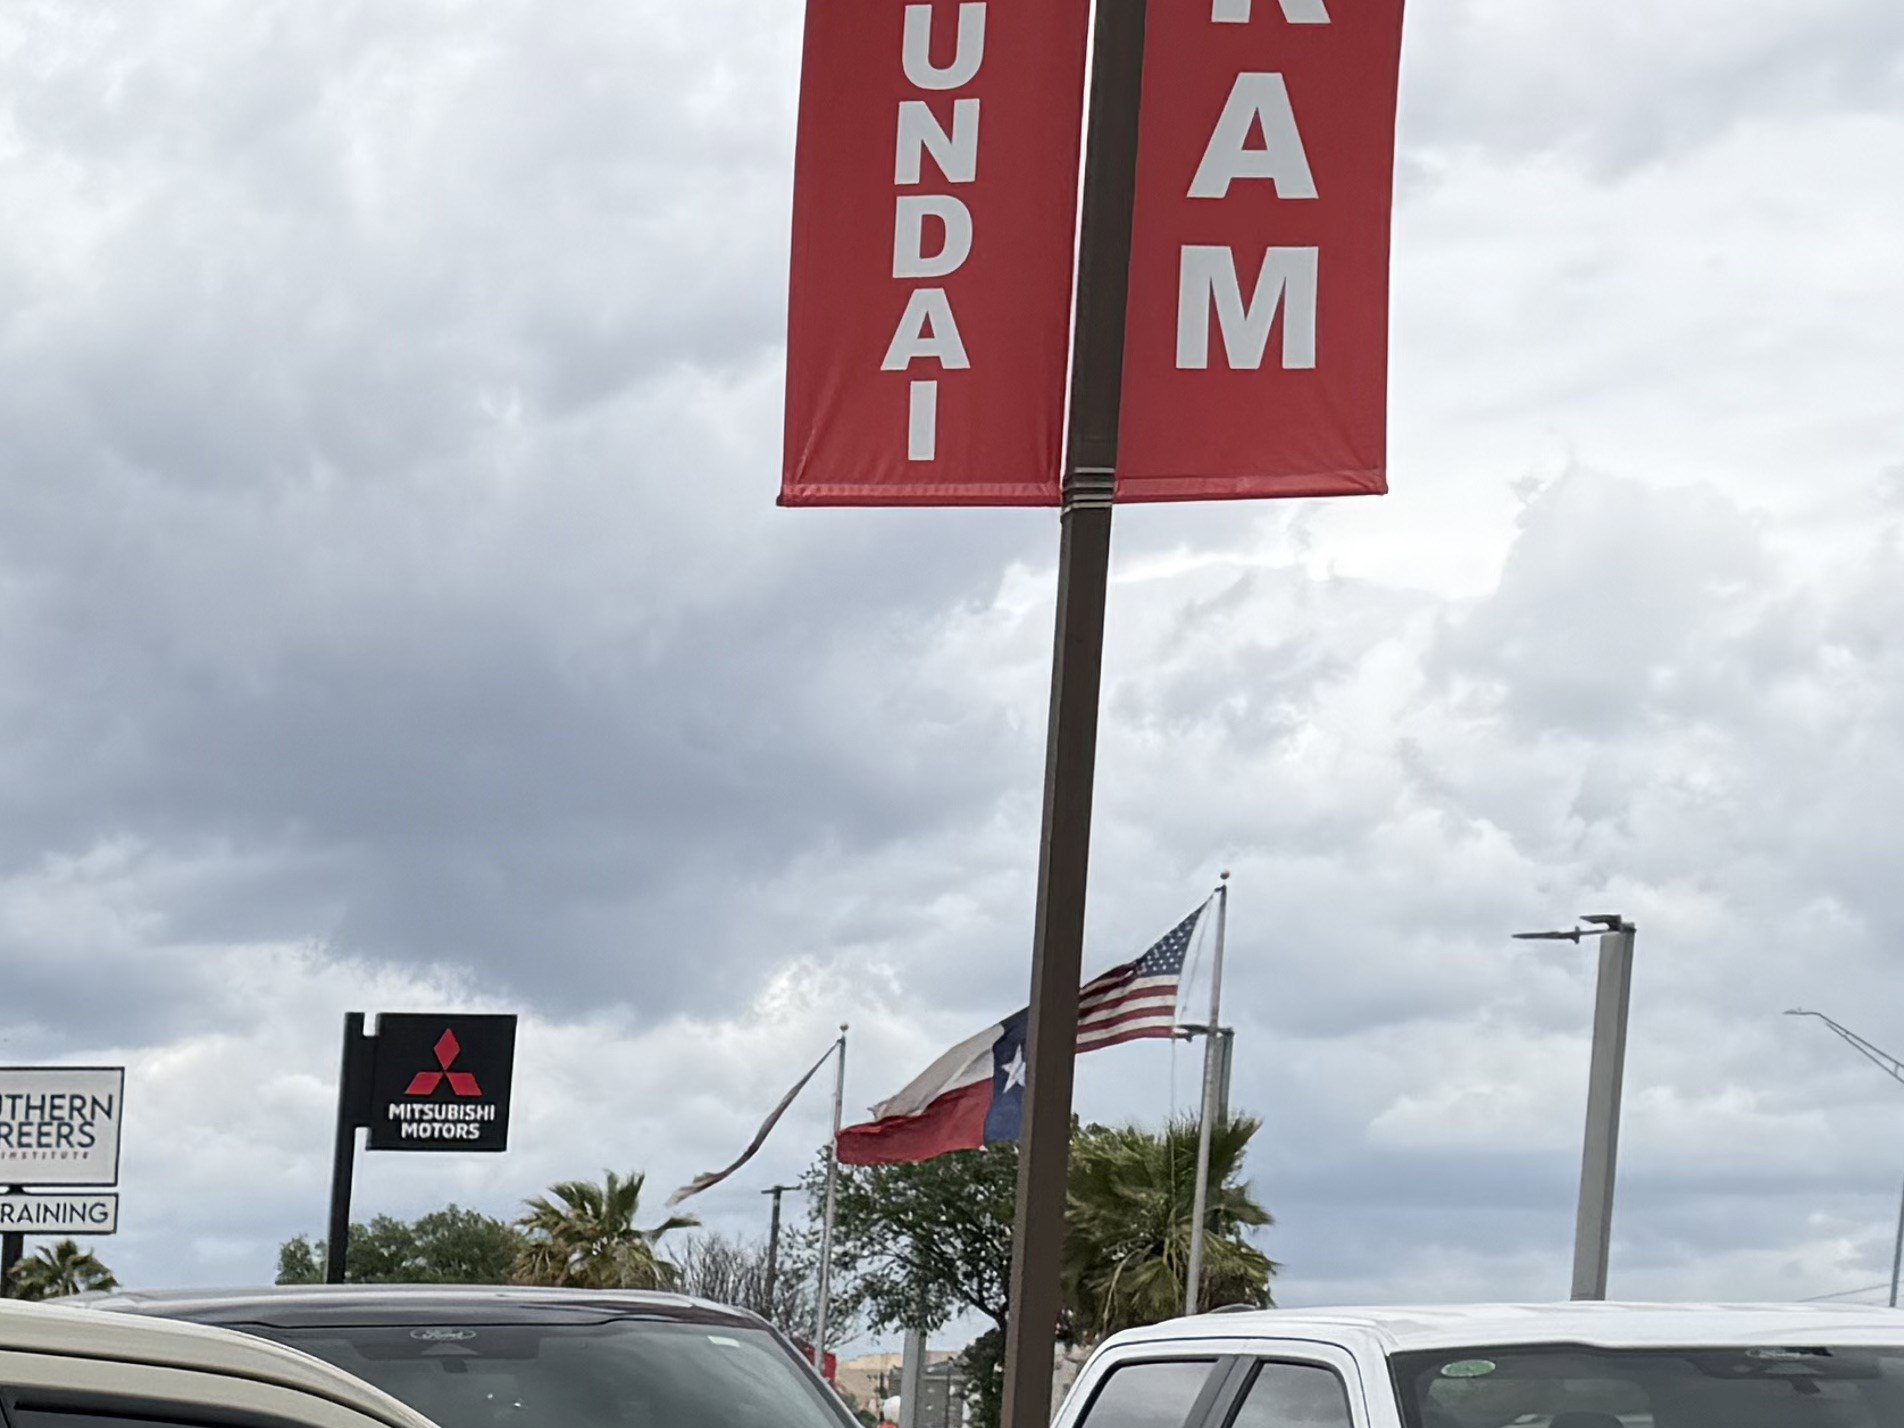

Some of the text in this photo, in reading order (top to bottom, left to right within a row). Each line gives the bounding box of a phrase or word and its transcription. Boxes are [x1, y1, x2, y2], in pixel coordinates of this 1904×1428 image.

[879, 1, 987, 462] UNDAI
[1174, 0, 1331, 371] AM
[388, 1103, 495, 1121] MITSUBISHI
[400, 1122, 481, 1139] MOTORS
